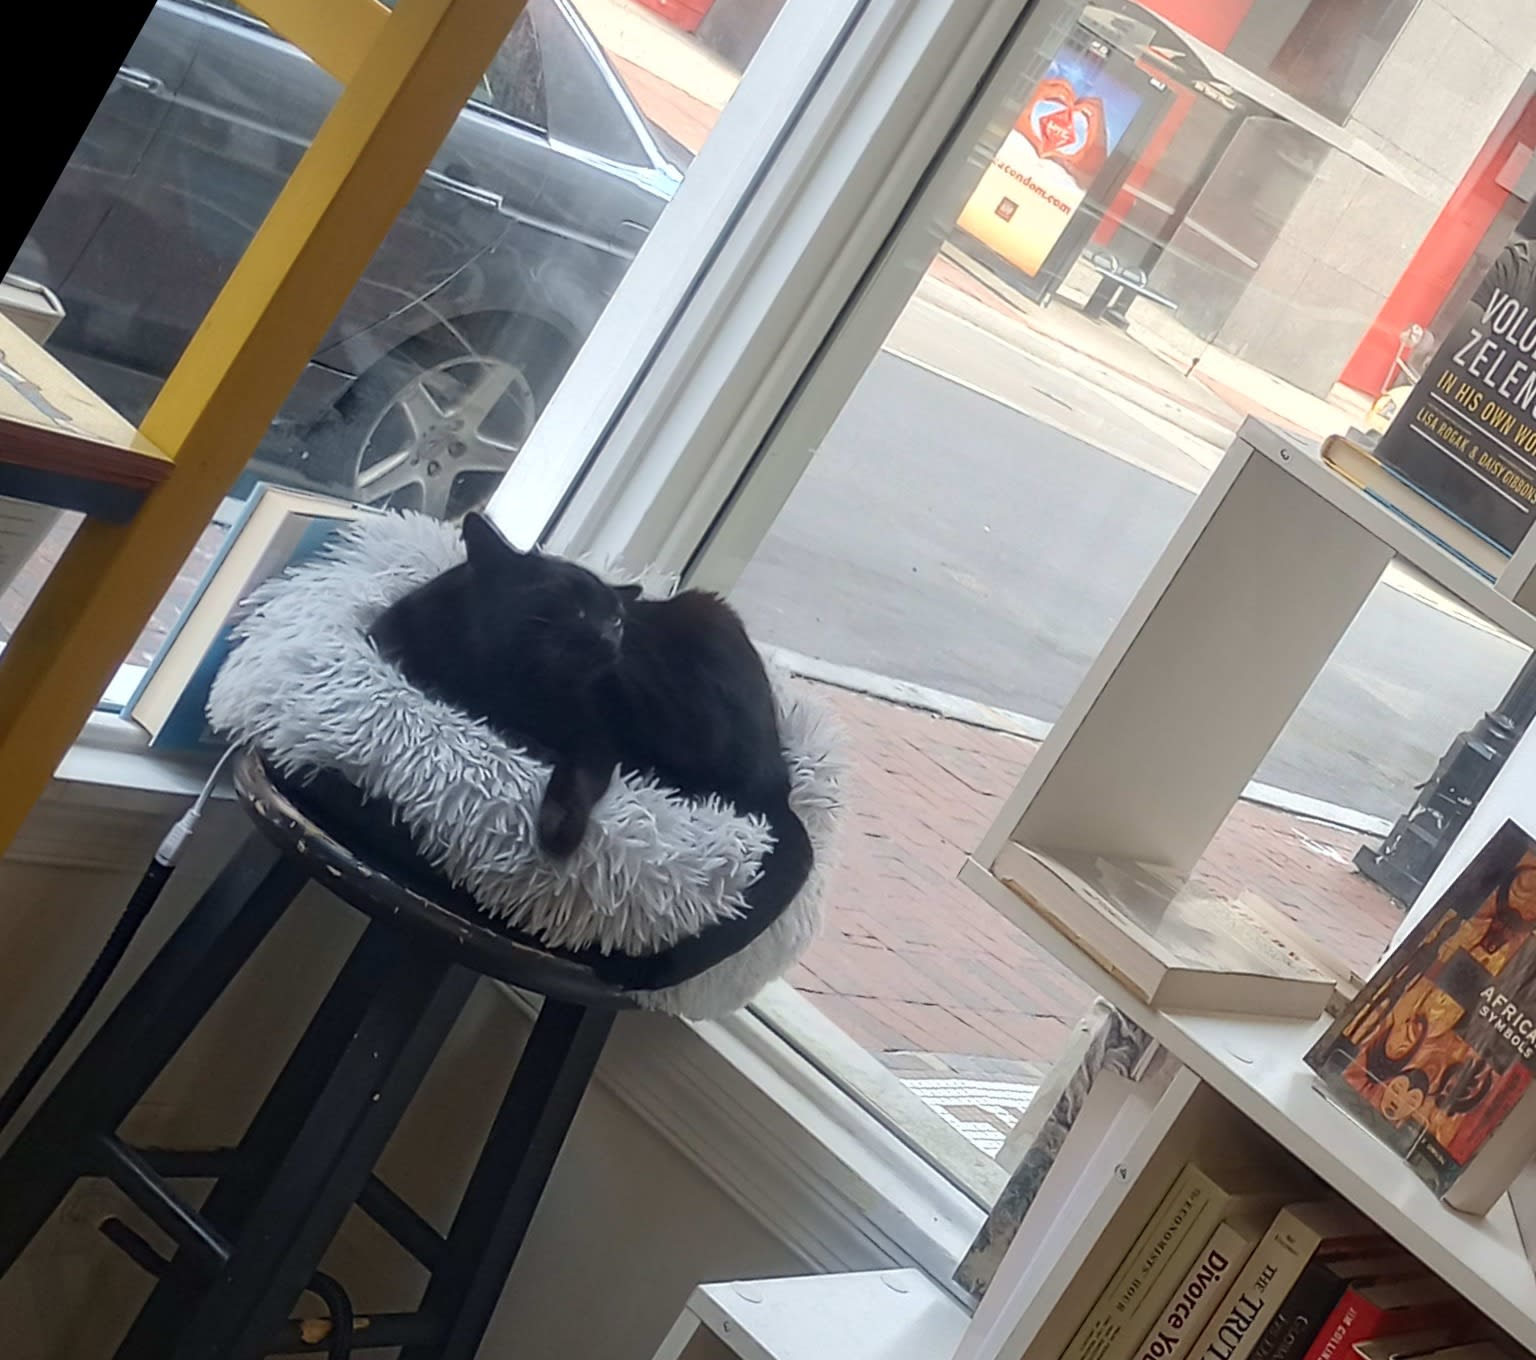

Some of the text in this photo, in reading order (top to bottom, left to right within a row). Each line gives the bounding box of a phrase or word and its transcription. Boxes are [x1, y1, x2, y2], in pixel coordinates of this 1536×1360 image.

[1435, 370, 1458, 396] IN
[1452, 382, 1483, 414] HIS
[1478, 401, 1516, 437] OWN
[1416, 406, 1439, 431] LISA
[1468, 445, 1480, 462] &
[1476, 451, 1506, 480] DAISY
[1478, 1005, 1535, 1060] SYMBOLS
[1166, 1249, 1228, 1331] Divorce
[1251, 1262, 1277, 1294] THE
[1337, 1306, 1356, 1329] JIM
